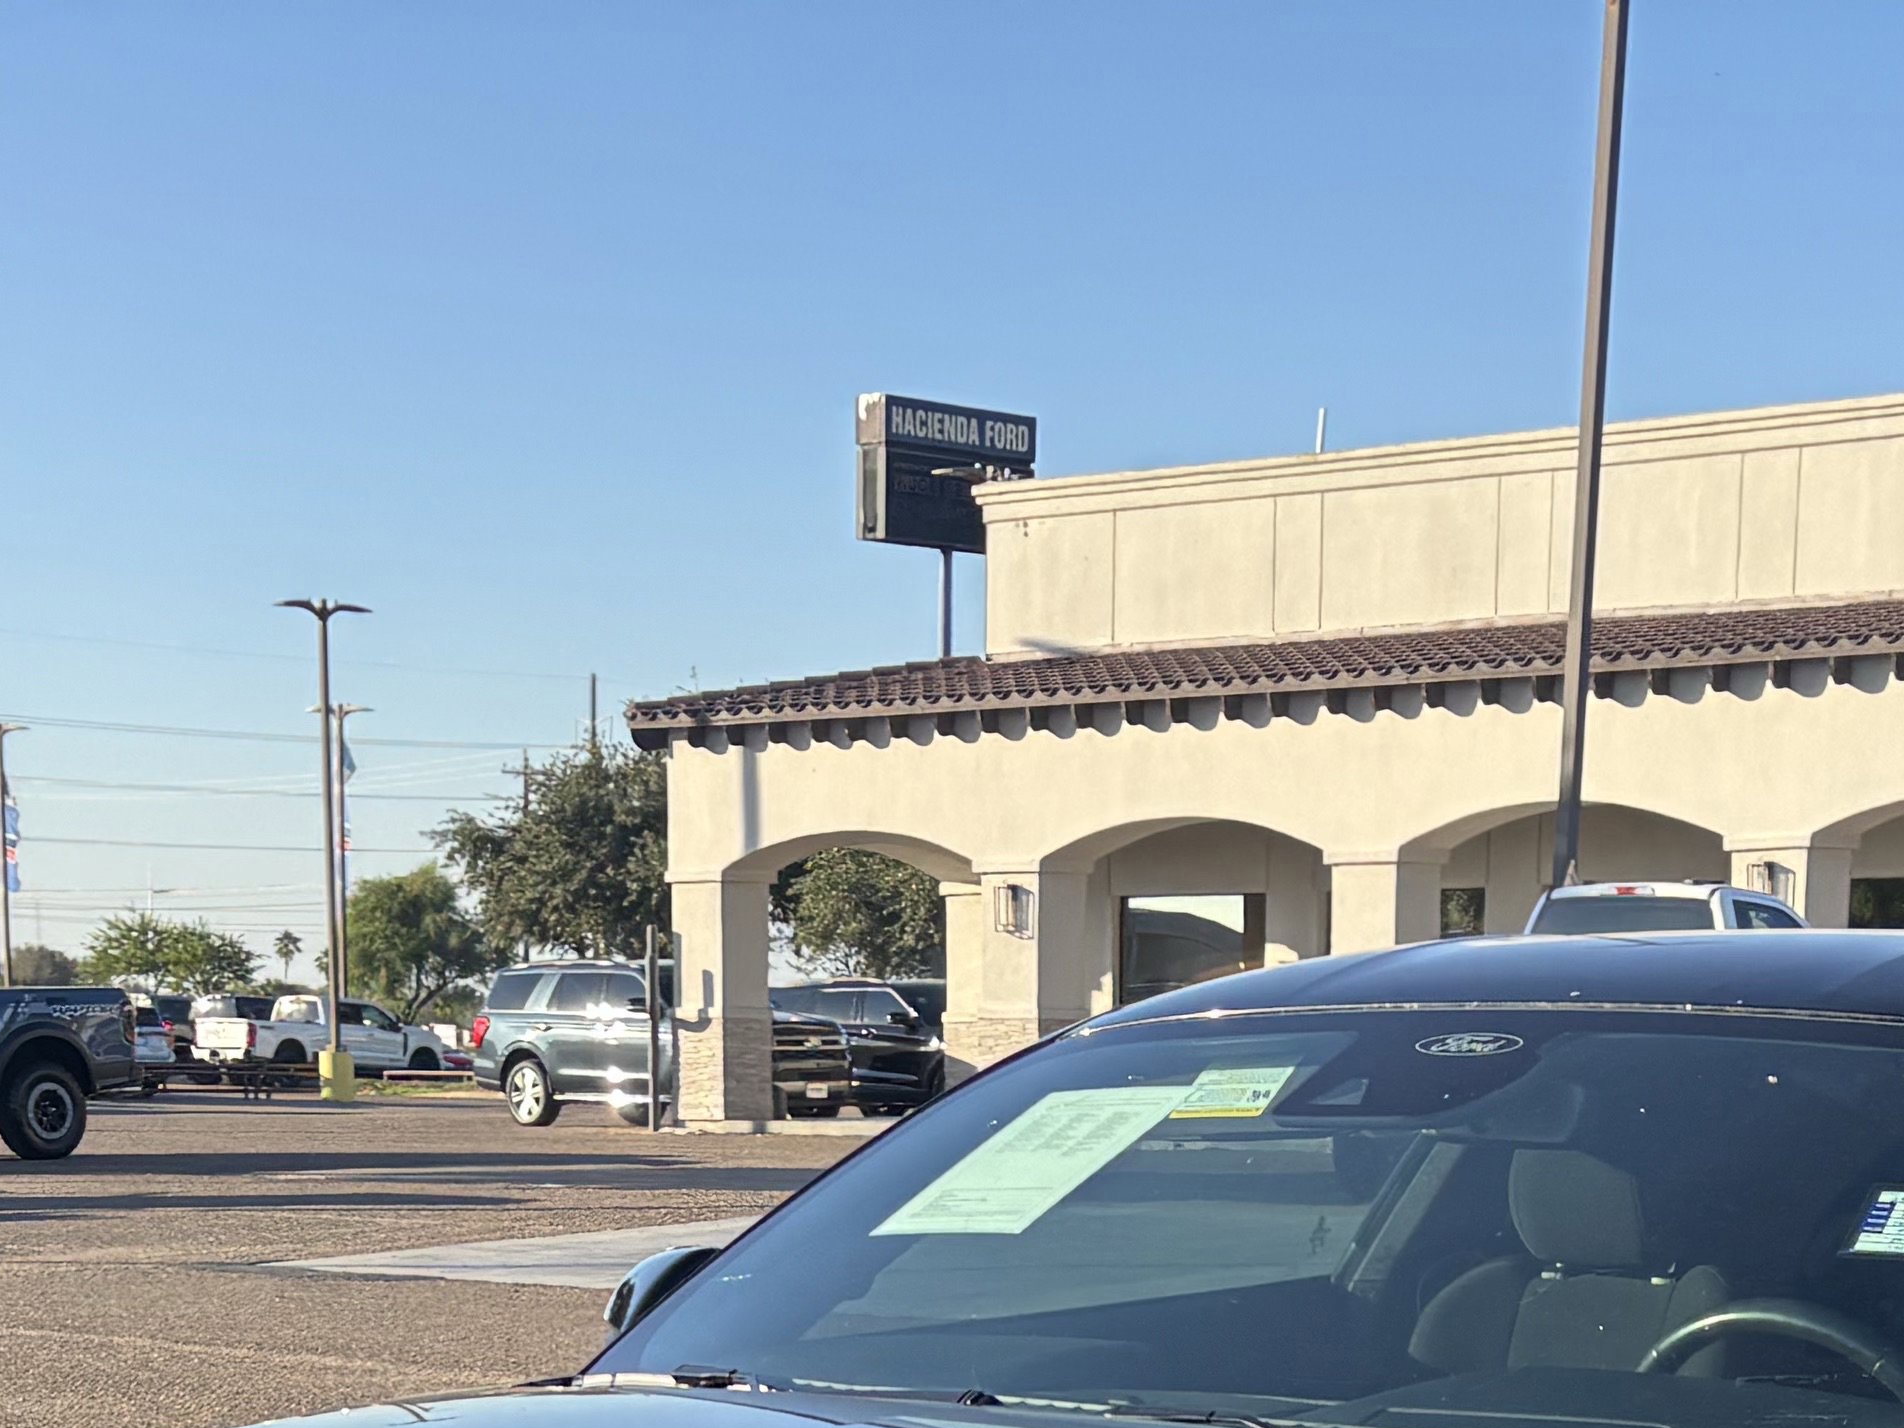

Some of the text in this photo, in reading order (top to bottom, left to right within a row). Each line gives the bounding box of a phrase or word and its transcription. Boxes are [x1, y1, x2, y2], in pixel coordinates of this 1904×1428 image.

[891, 405, 1030, 453] HACIENDA FORD
[1430, 1036, 1507, 1052] Ford
